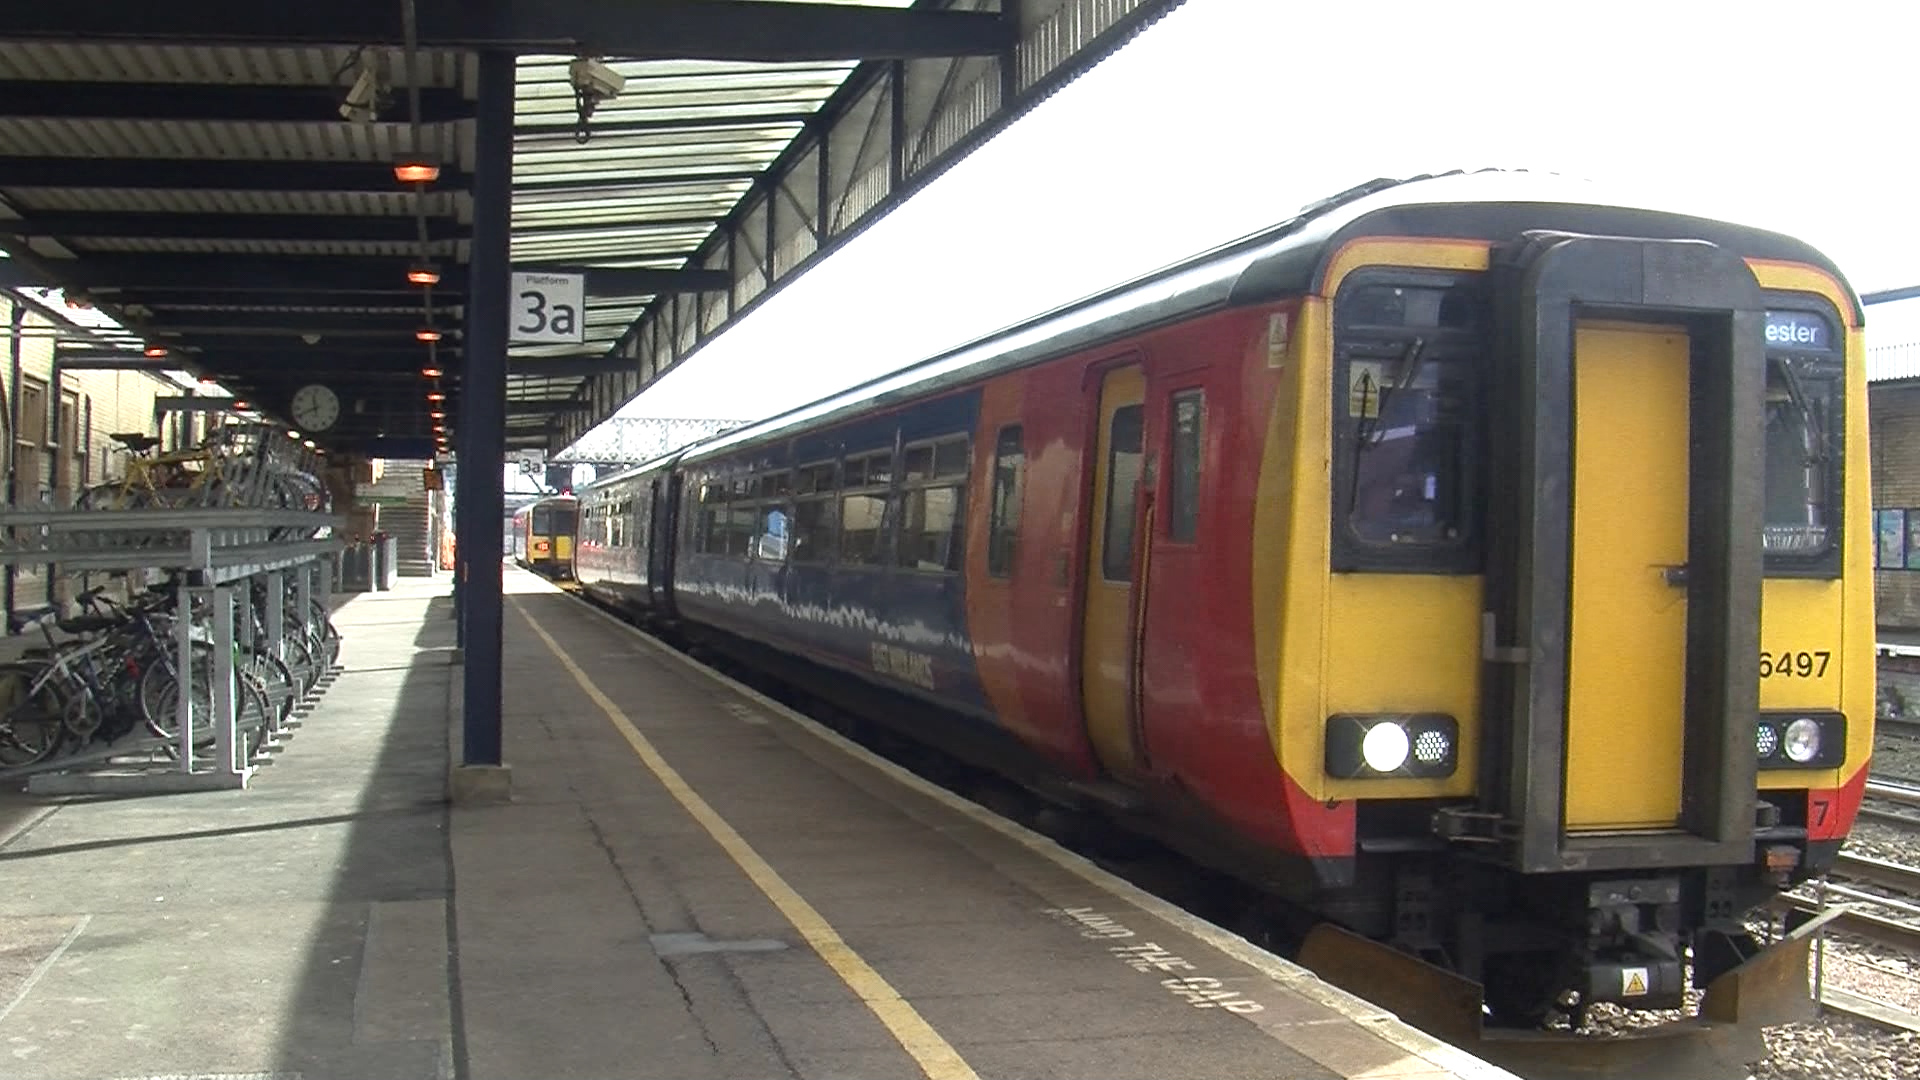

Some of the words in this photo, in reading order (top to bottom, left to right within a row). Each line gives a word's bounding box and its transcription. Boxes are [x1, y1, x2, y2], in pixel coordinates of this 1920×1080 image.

[526, 275, 569, 285] Platform
[517, 290, 575, 335] 3a
[1765, 321, 1819, 343] ester
[520, 458, 542, 473] 3a
[1759, 651, 1831, 678] 6497
[1813, 801, 1829, 827] 7
[1043, 906, 1136, 940] MIND
[1109, 942, 1197, 973] THE
[1160, 976, 1265, 1014] GAP
